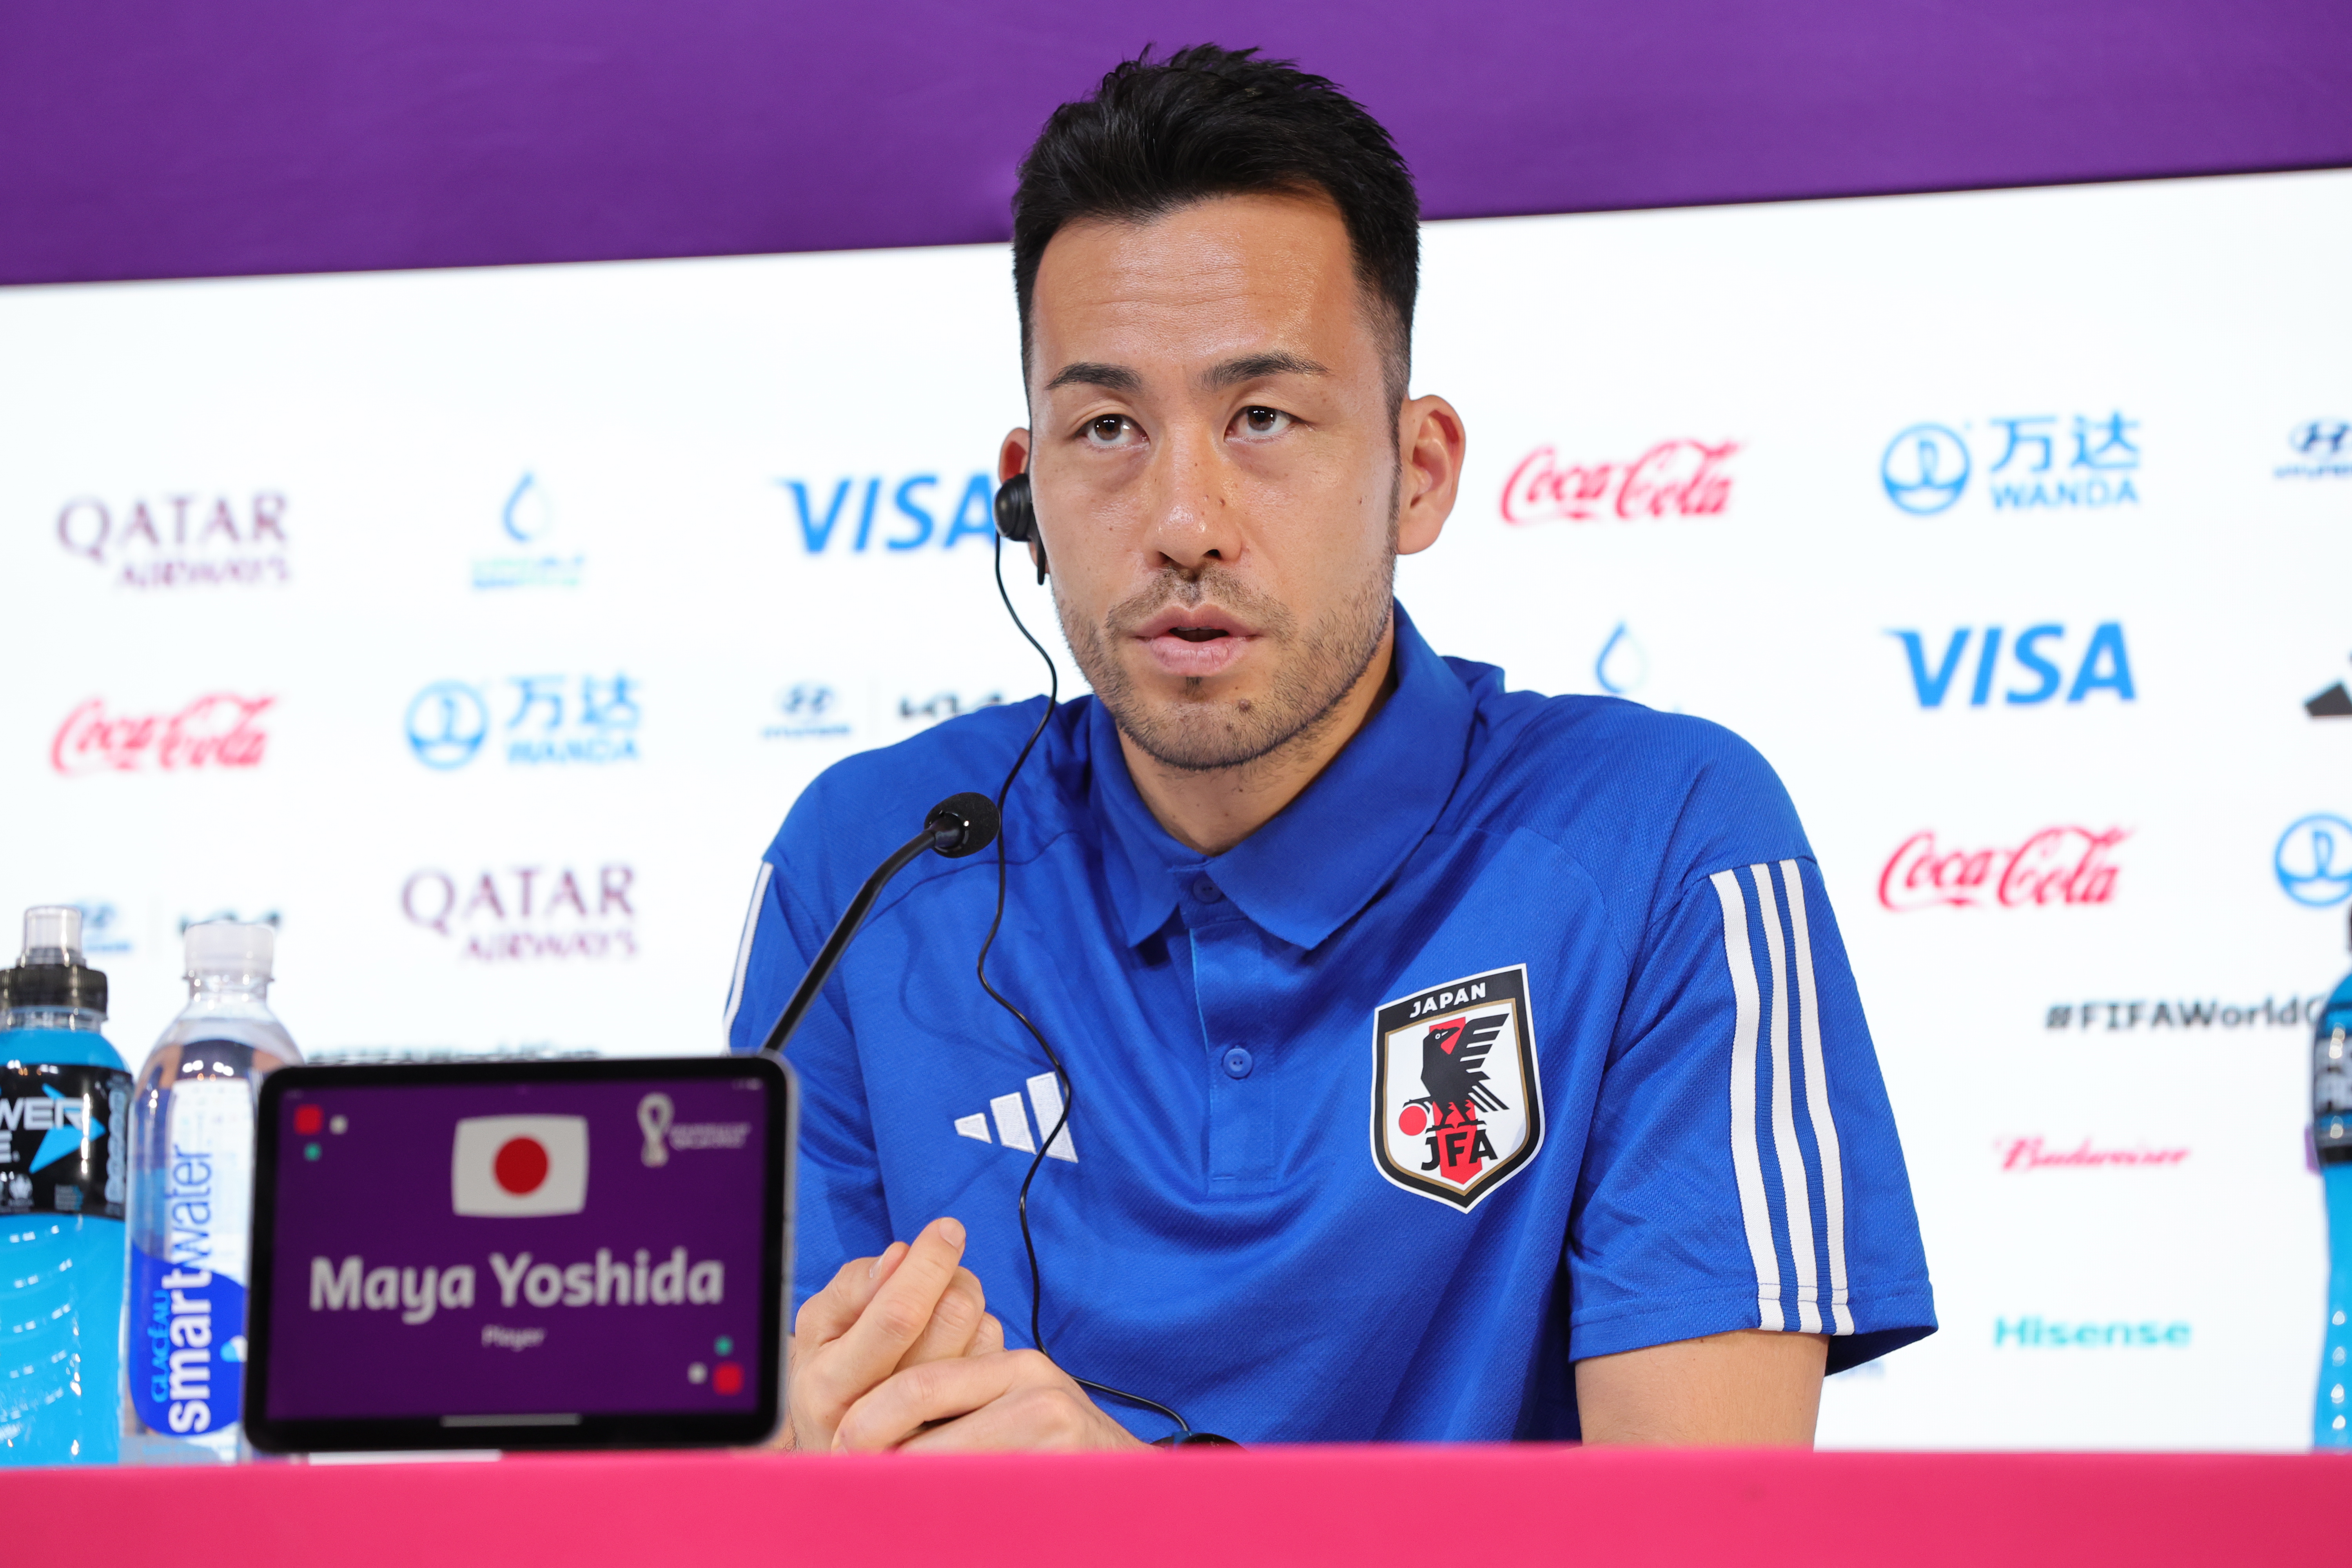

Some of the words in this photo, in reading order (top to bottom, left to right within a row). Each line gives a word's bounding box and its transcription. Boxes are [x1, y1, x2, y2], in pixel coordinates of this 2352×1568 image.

[1989, 410, 2139, 474] 万达
[778, 473, 998, 553] VISA
[1498, 436, 1746, 525] Coca-Cola
[1989, 476, 2139, 511] WANDA
[54, 489, 288, 561] QATAR
[1886, 621, 2137, 710] VISA
[399, 862, 636, 935] QATAR
[1875, 823, 2132, 911] Coca-Cola
[1409, 982, 1486, 1018] JAPAN
[1421, 1129, 1499, 1171] JFA
[1996, 1135, 2190, 1172] Budweiser
[310, 1256, 475, 1325] Maya
[489, 1246, 725, 1308] Yoshida
[481, 1325, 544, 1351] Player
[1992, 1314, 2193, 1348] Hisense
